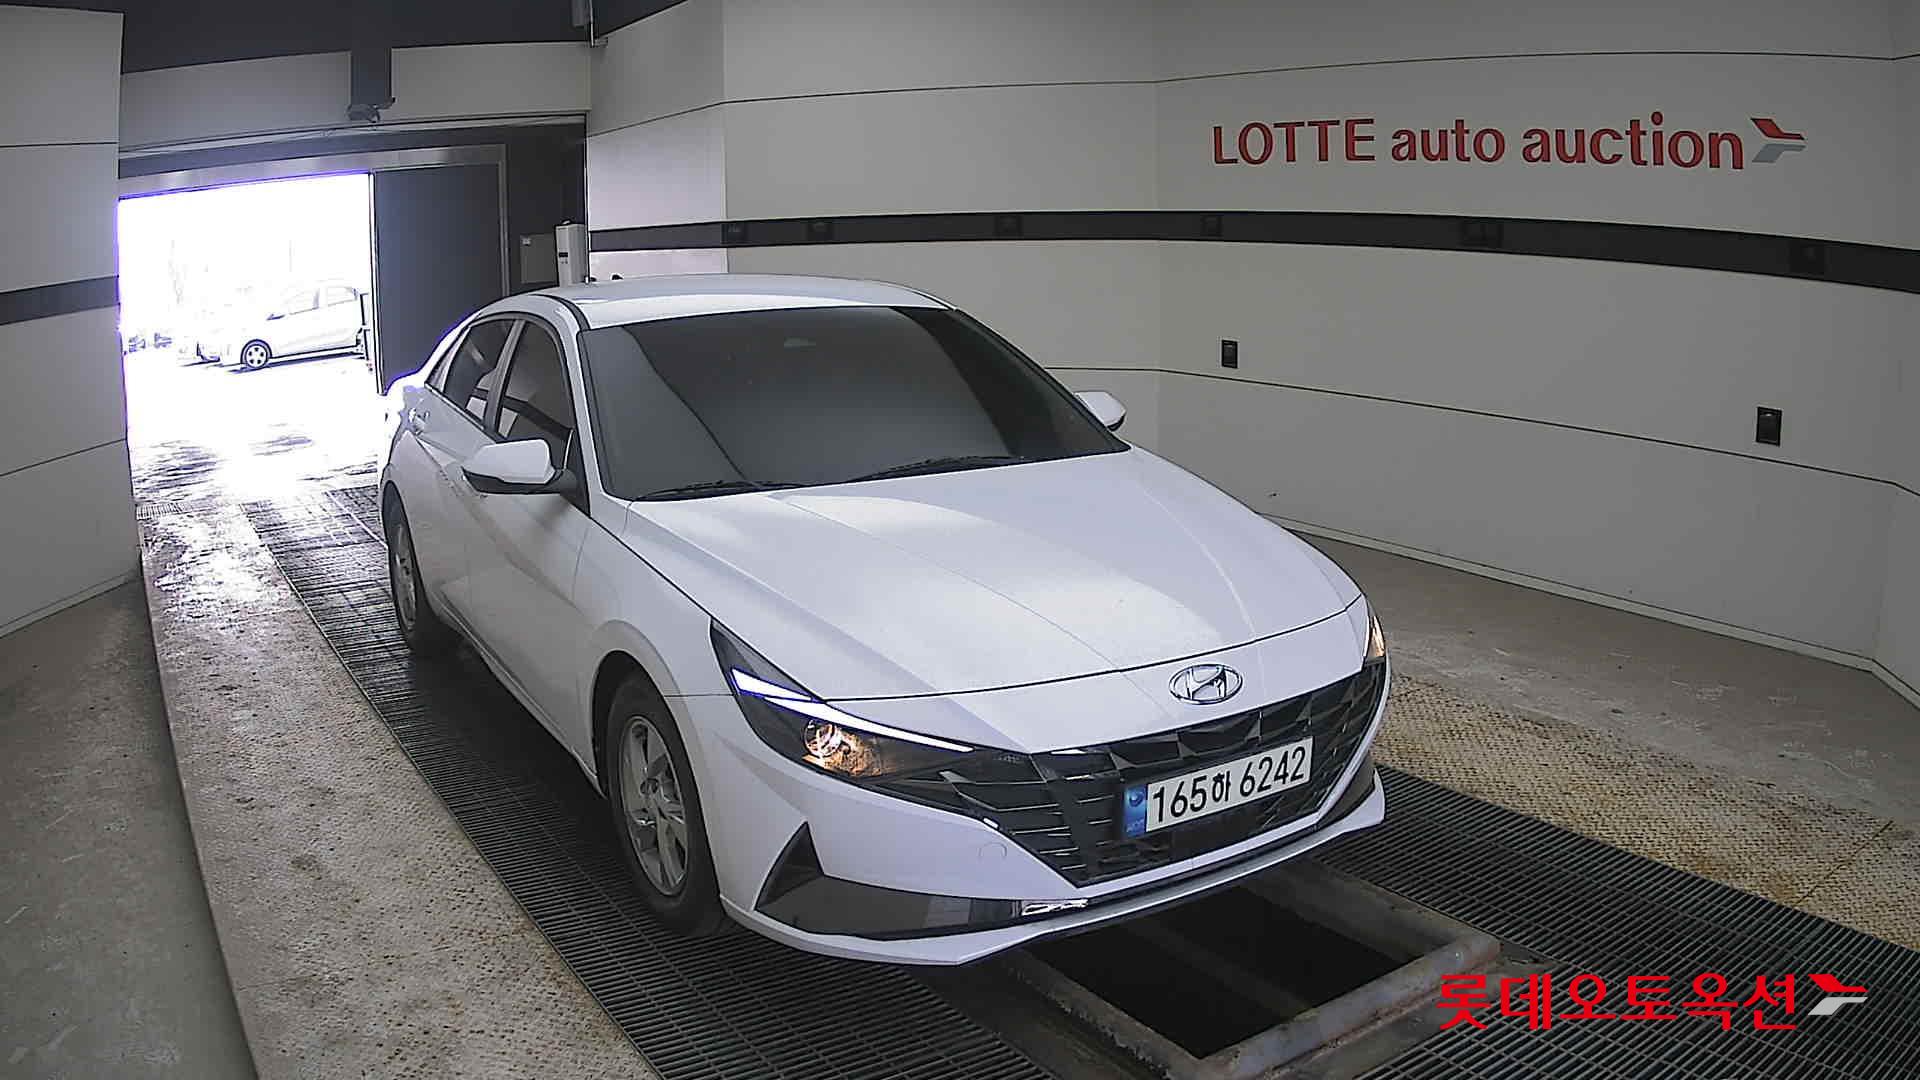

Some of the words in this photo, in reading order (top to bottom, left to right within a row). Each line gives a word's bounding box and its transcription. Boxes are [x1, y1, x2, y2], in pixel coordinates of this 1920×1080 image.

[1212, 118, 1376, 165] LOTTE
[1391, 119, 1505, 163] auto
[1522, 112, 1745, 170] auction
[1152, 770, 1232, 823] 165하
[1239, 746, 1306, 798] 6242
